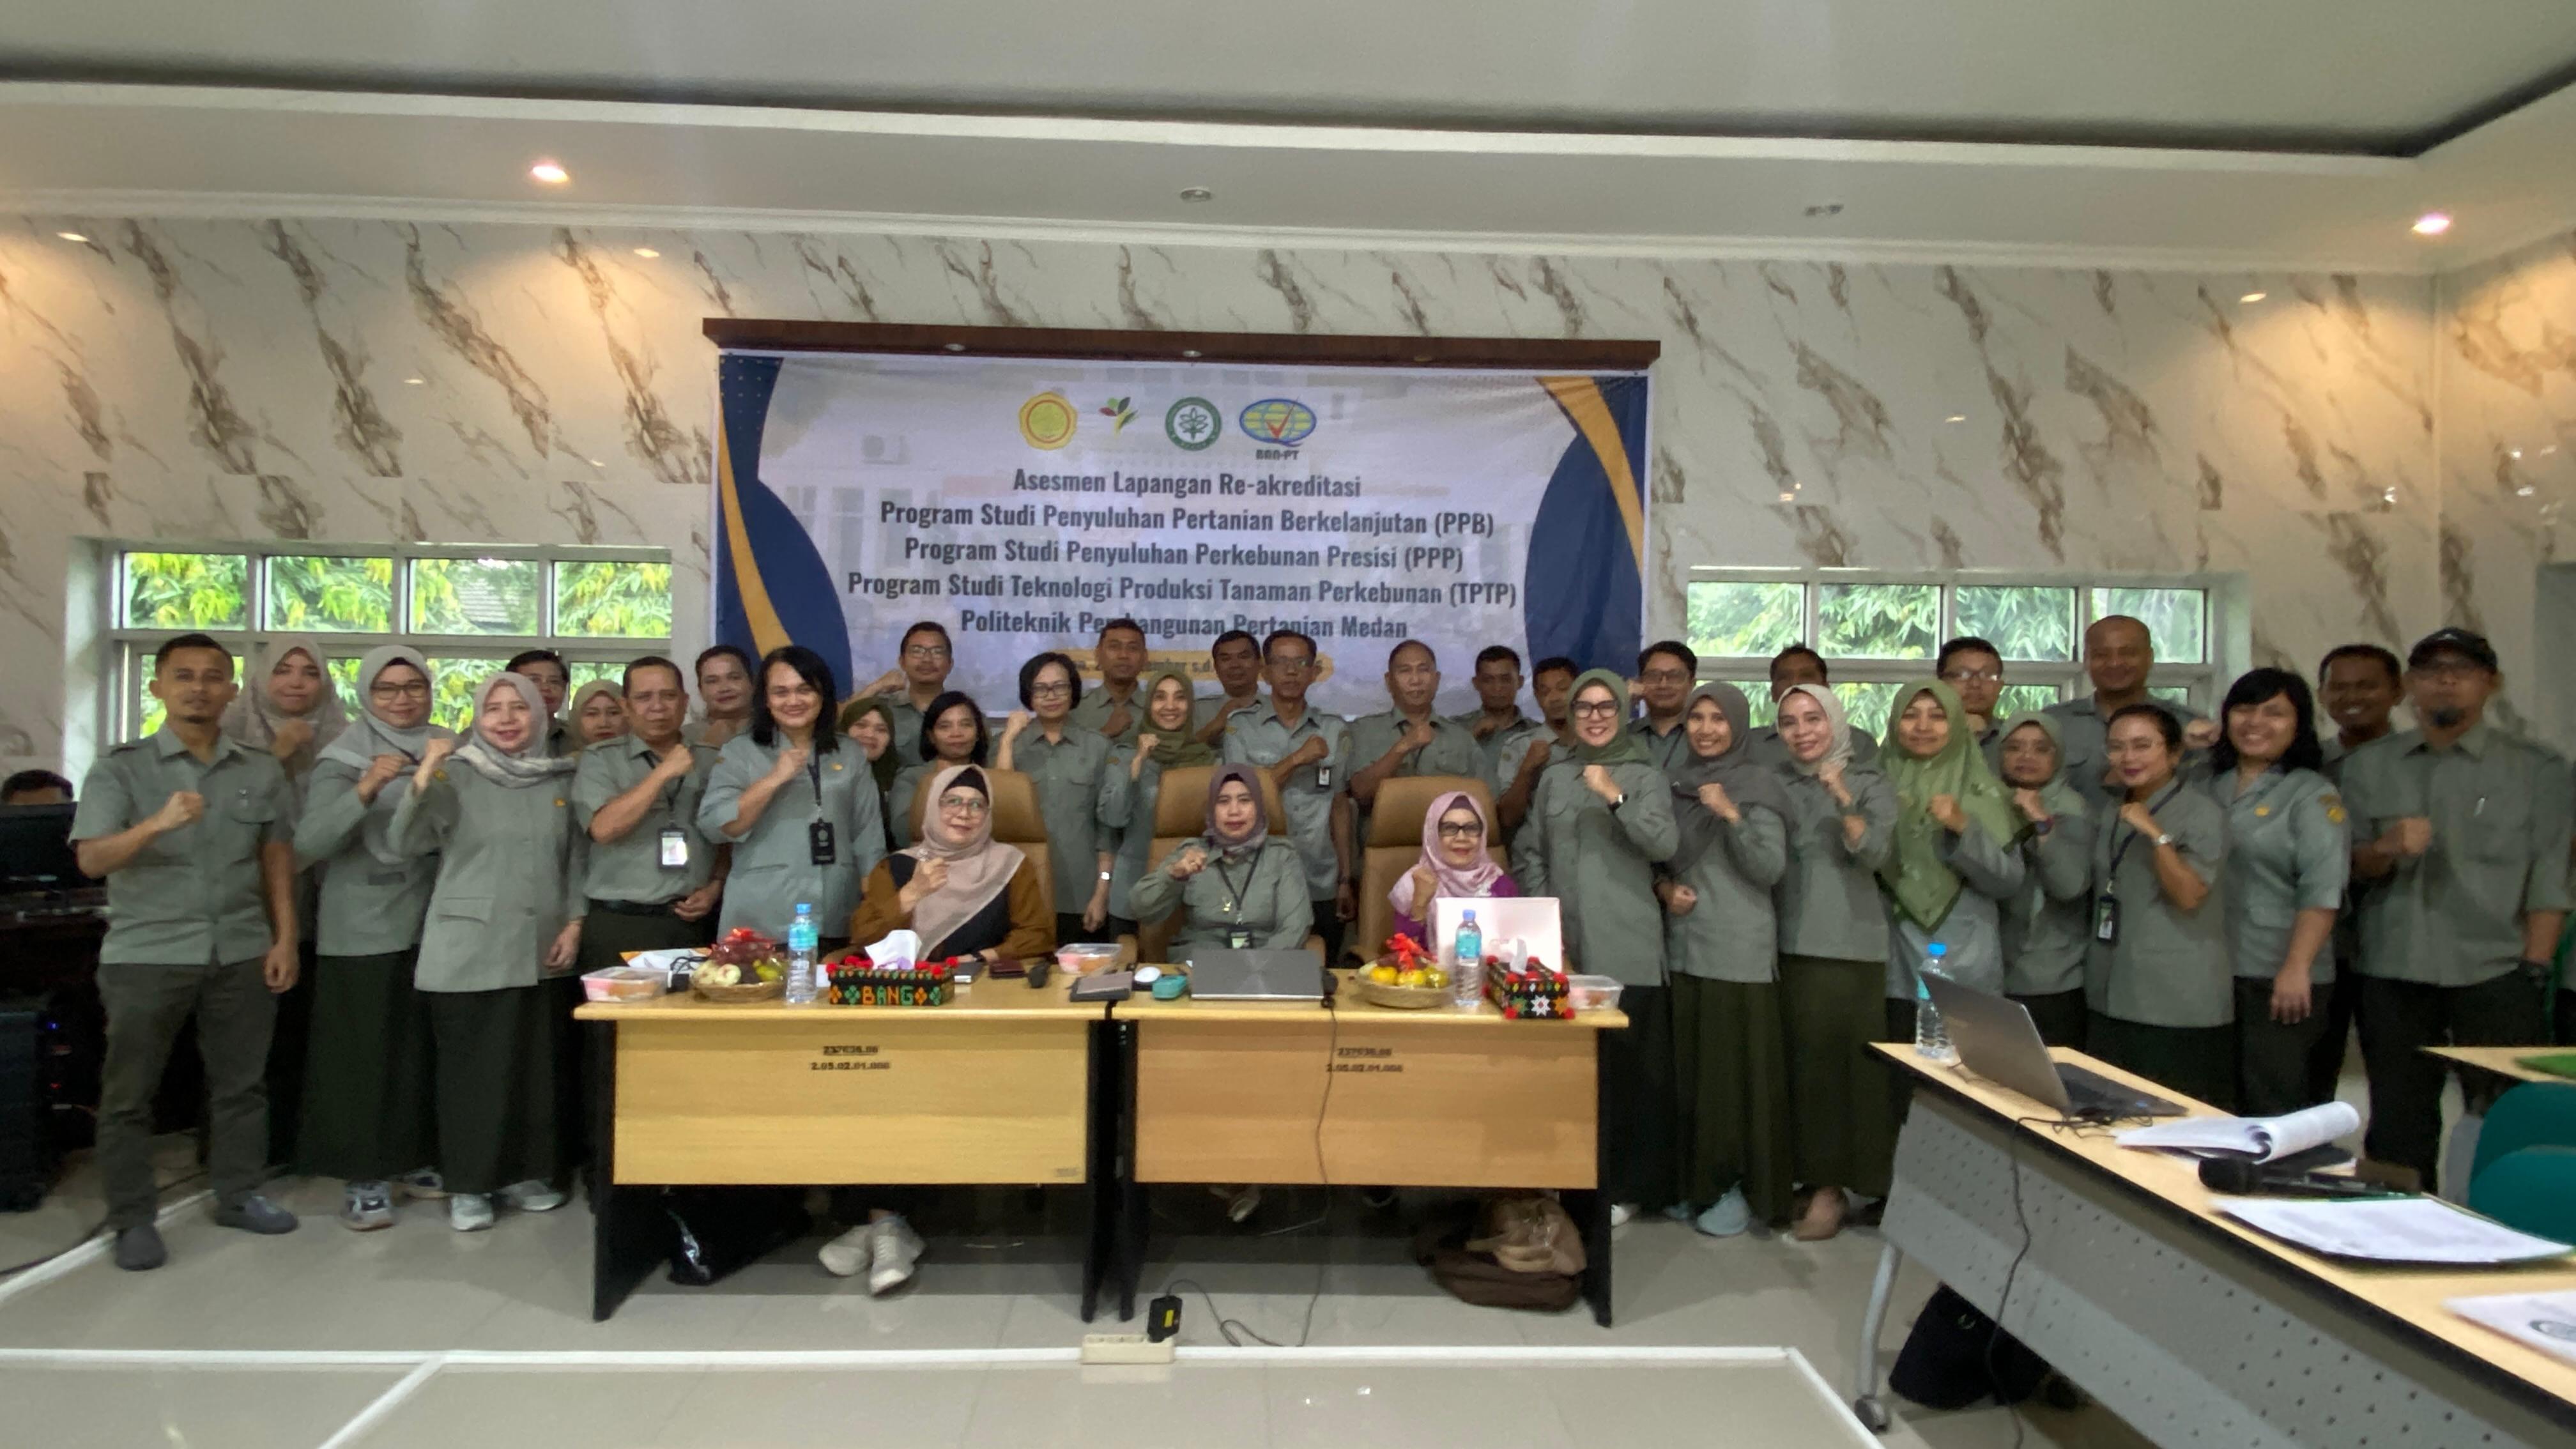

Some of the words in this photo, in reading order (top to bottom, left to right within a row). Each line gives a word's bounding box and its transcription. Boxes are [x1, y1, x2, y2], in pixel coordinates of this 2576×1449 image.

[1013, 469, 1105, 492] Asesmen
[1114, 471, 1212, 498] Lapangan
[1219, 473, 1361, 497] Re-akreditasi
[880, 501, 973, 528] Program
[981, 503, 1035, 526] Studi
[1043, 505, 1164, 531] Penyuluhan
[1172, 508, 1273, 531] Pertanian
[1281, 510, 1427, 537] Berkelanjutan
[1434, 512, 1494, 538] (PPB)
[905, 537, 997, 564] Program
[1005, 539, 1059, 562] Studi
[1067, 540, 1188, 567] Penyuluhan
[1195, 544, 1319, 567] Perkebunan
[1328, 546, 1396, 568] Presisi
[1405, 547, 1463, 572] (PPP)
[848, 572, 940, 599] Program
[948, 574, 1003, 597] Studi
[1011, 575, 1112, 602] Teknologi
[1120, 577, 1213, 600] Produksi
[1219, 579, 1311, 602] Tanaman
[1319, 580, 1442, 603] Perkebunan
[1450, 583, 1517, 609] (TPTP)
[962, 610, 1071, 632] Politeknik
[1078, 611, 1225, 638] Peangunan
[1233, 614, 1333, 637] Pertanian
[1341, 617, 1407, 638] Medan
[862, 986, 914, 1005] BANG
